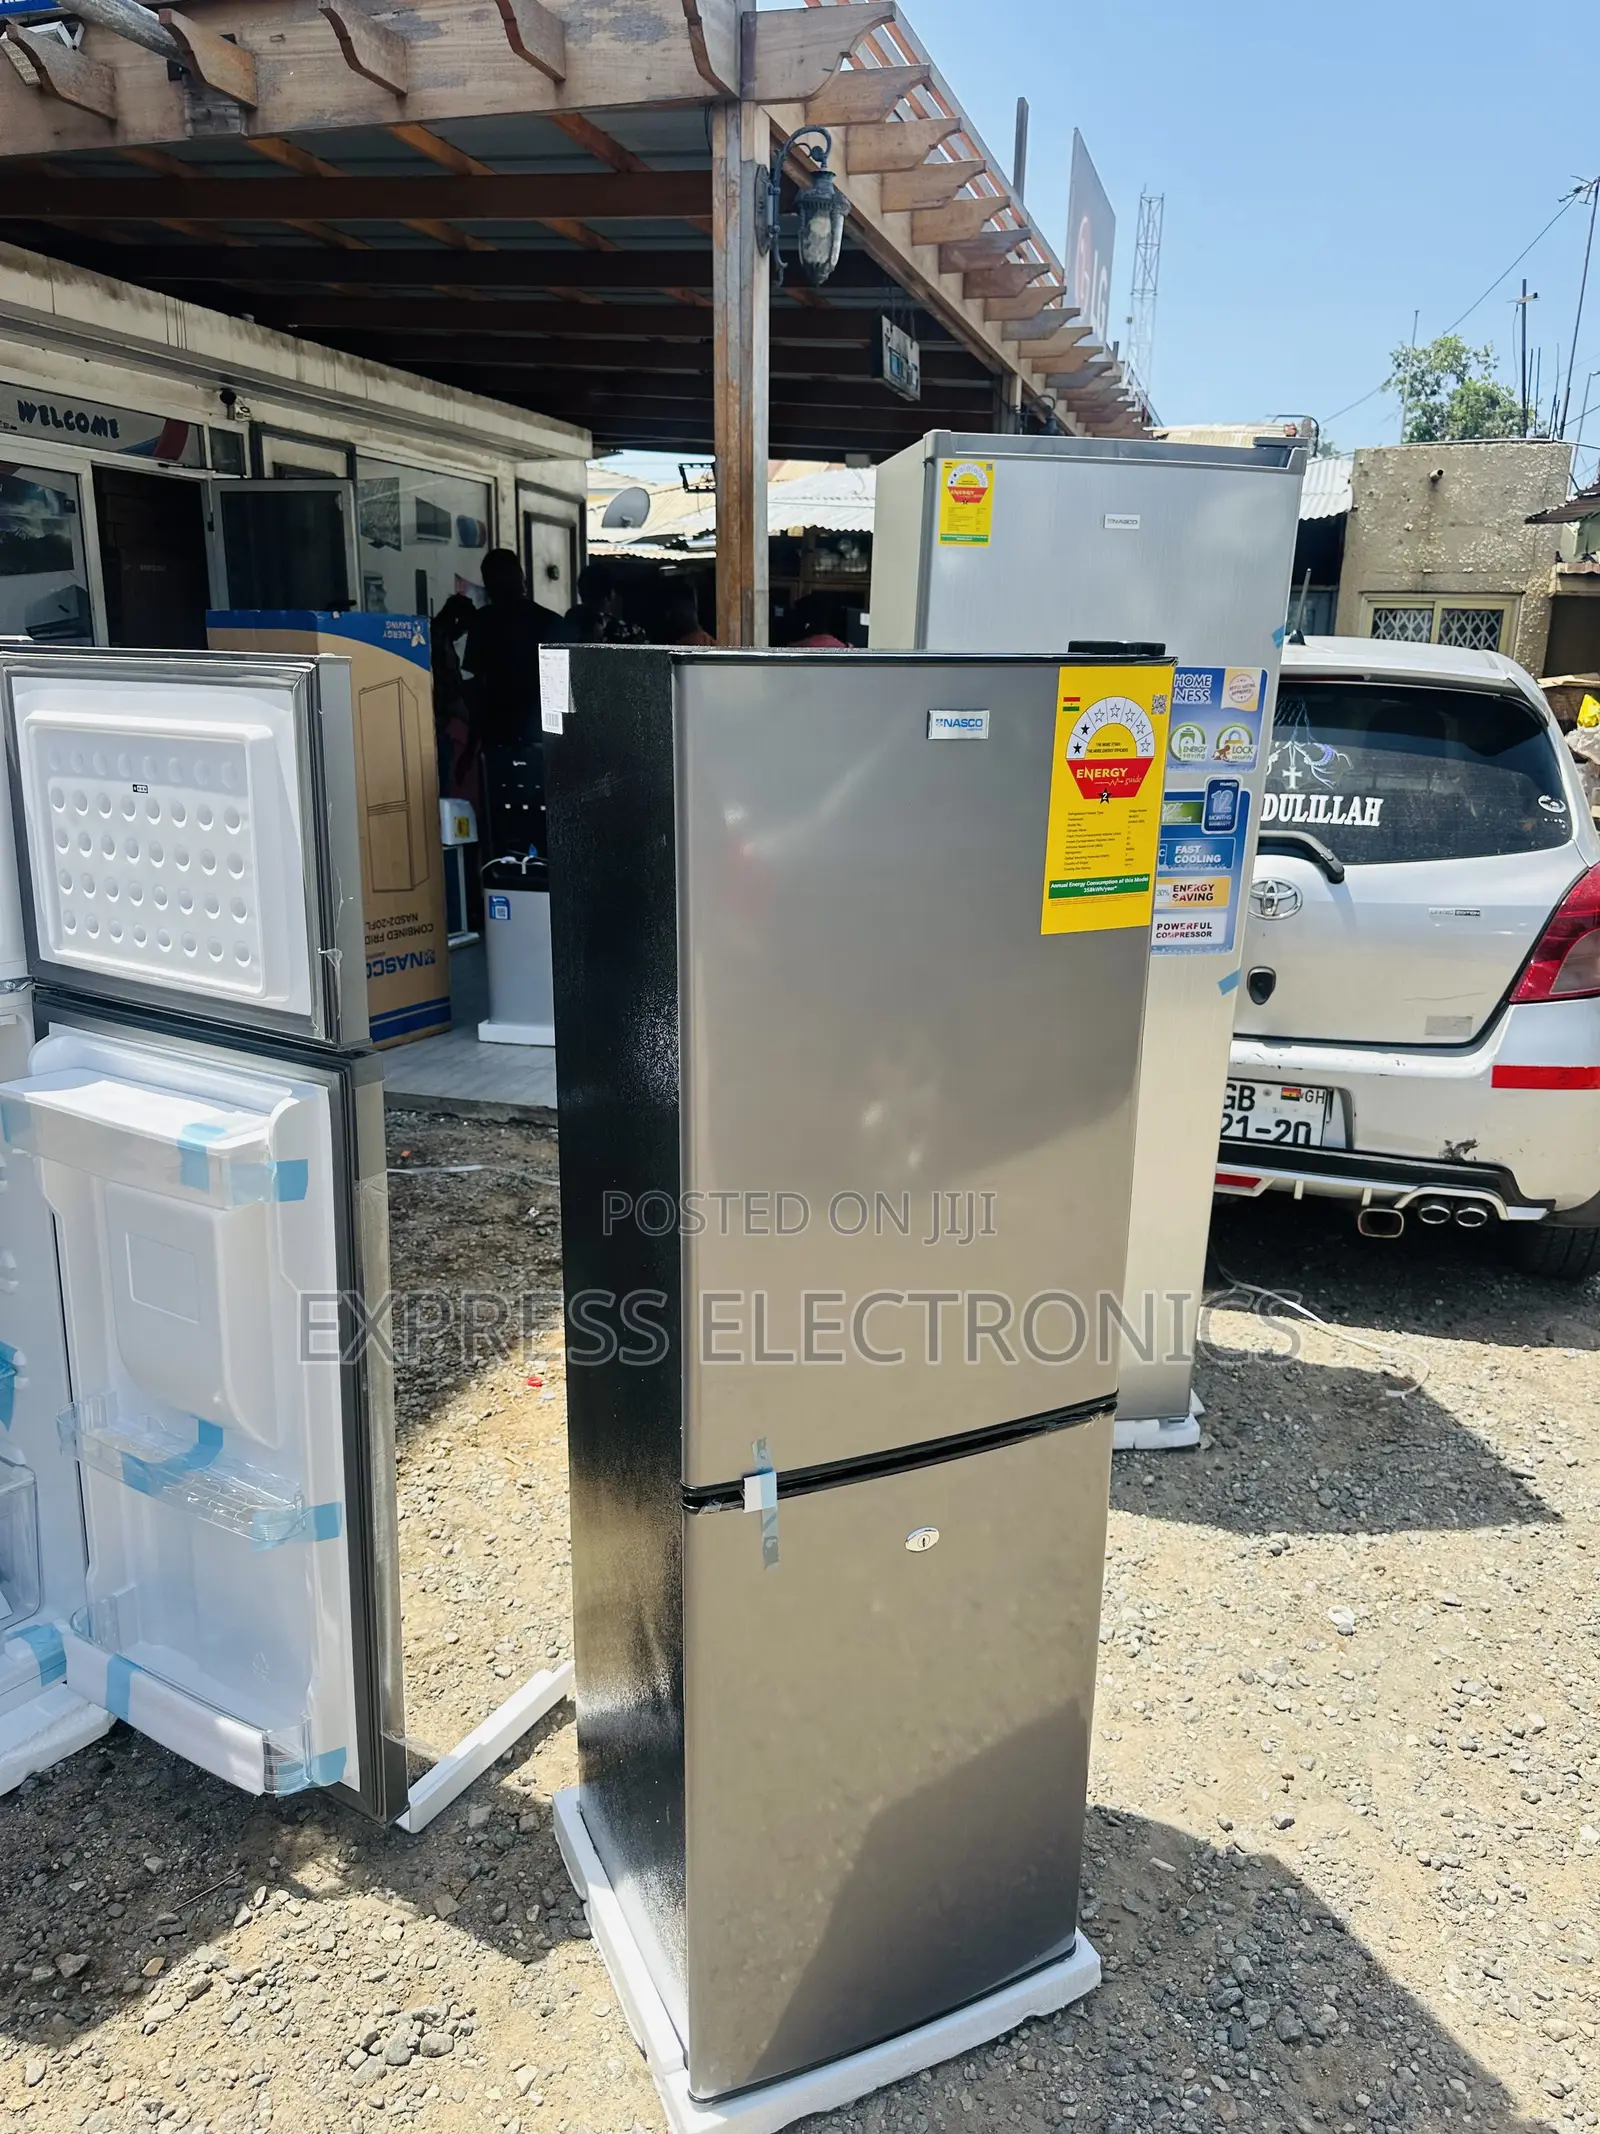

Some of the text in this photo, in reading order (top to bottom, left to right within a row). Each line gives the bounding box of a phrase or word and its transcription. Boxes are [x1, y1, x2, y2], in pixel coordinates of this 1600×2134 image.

[1090, 248, 1108, 344] LG
[16, 399, 120, 440] WELCOME
[1174, 674, 1213, 688] HOME
[943, 718, 983, 728] NASCO
[1232, 746, 1253, 754] LOCK
[1076, 765, 1128, 781] ENERGY
[1102, 792, 1108, 800] 2
[1211, 790, 1234, 813] 12
[1260, 793, 1384, 827] DULILLAH
[1175, 845, 1202, 854] FAST
[1174, 855, 1222, 864] COOLING
[1069, 881, 1086, 889] Energy
[1086, 879, 1118, 887] Consumption
[1173, 884, 1215, 892] ENERGY
[1172, 893, 1214, 902] SAVING
[387, 923, 434, 940] COMBINED
[1156, 922, 1213, 931] POWERFUL
[1156, 931, 1213, 939] COMPRESSOR
[1304, 1089, 1326, 1105] GH
